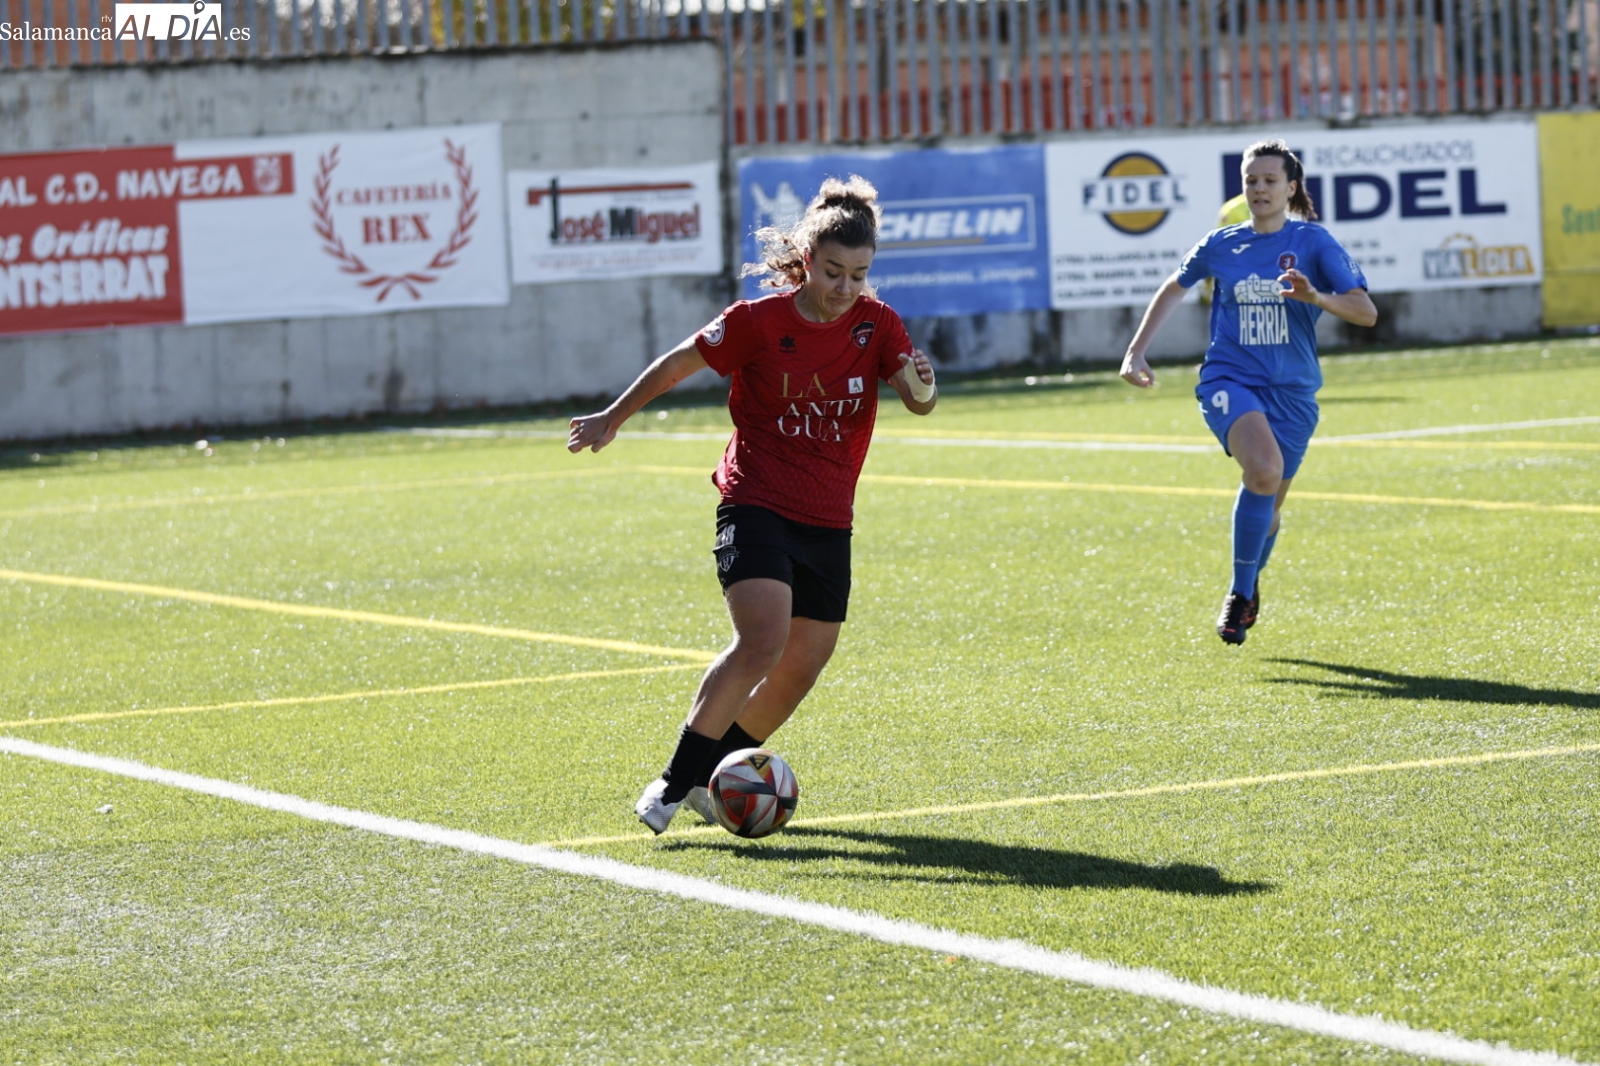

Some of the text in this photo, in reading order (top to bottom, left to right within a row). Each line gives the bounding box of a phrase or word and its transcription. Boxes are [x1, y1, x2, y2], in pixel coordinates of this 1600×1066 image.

[1314, 140, 1475, 167] RECAUCHUTADOS
[45, 171, 109, 206] C.D.
[116, 163, 245, 200] NAVEGA
[336, 180, 453, 206] CAFETERÍA
[1082, 178, 1187, 206] FIDEL
[548, 177, 700, 244] José Miguel
[876, 206, 1024, 243] CHELIN
[31, 217, 170, 260] Gráficas
[362, 210, 432, 246] REX
[1238, 304, 1290, 346] HERRIA
[779, 372, 829, 399] LA
[1211, 390, 1230, 416] 9
[777, 414, 842, 442] GUA
